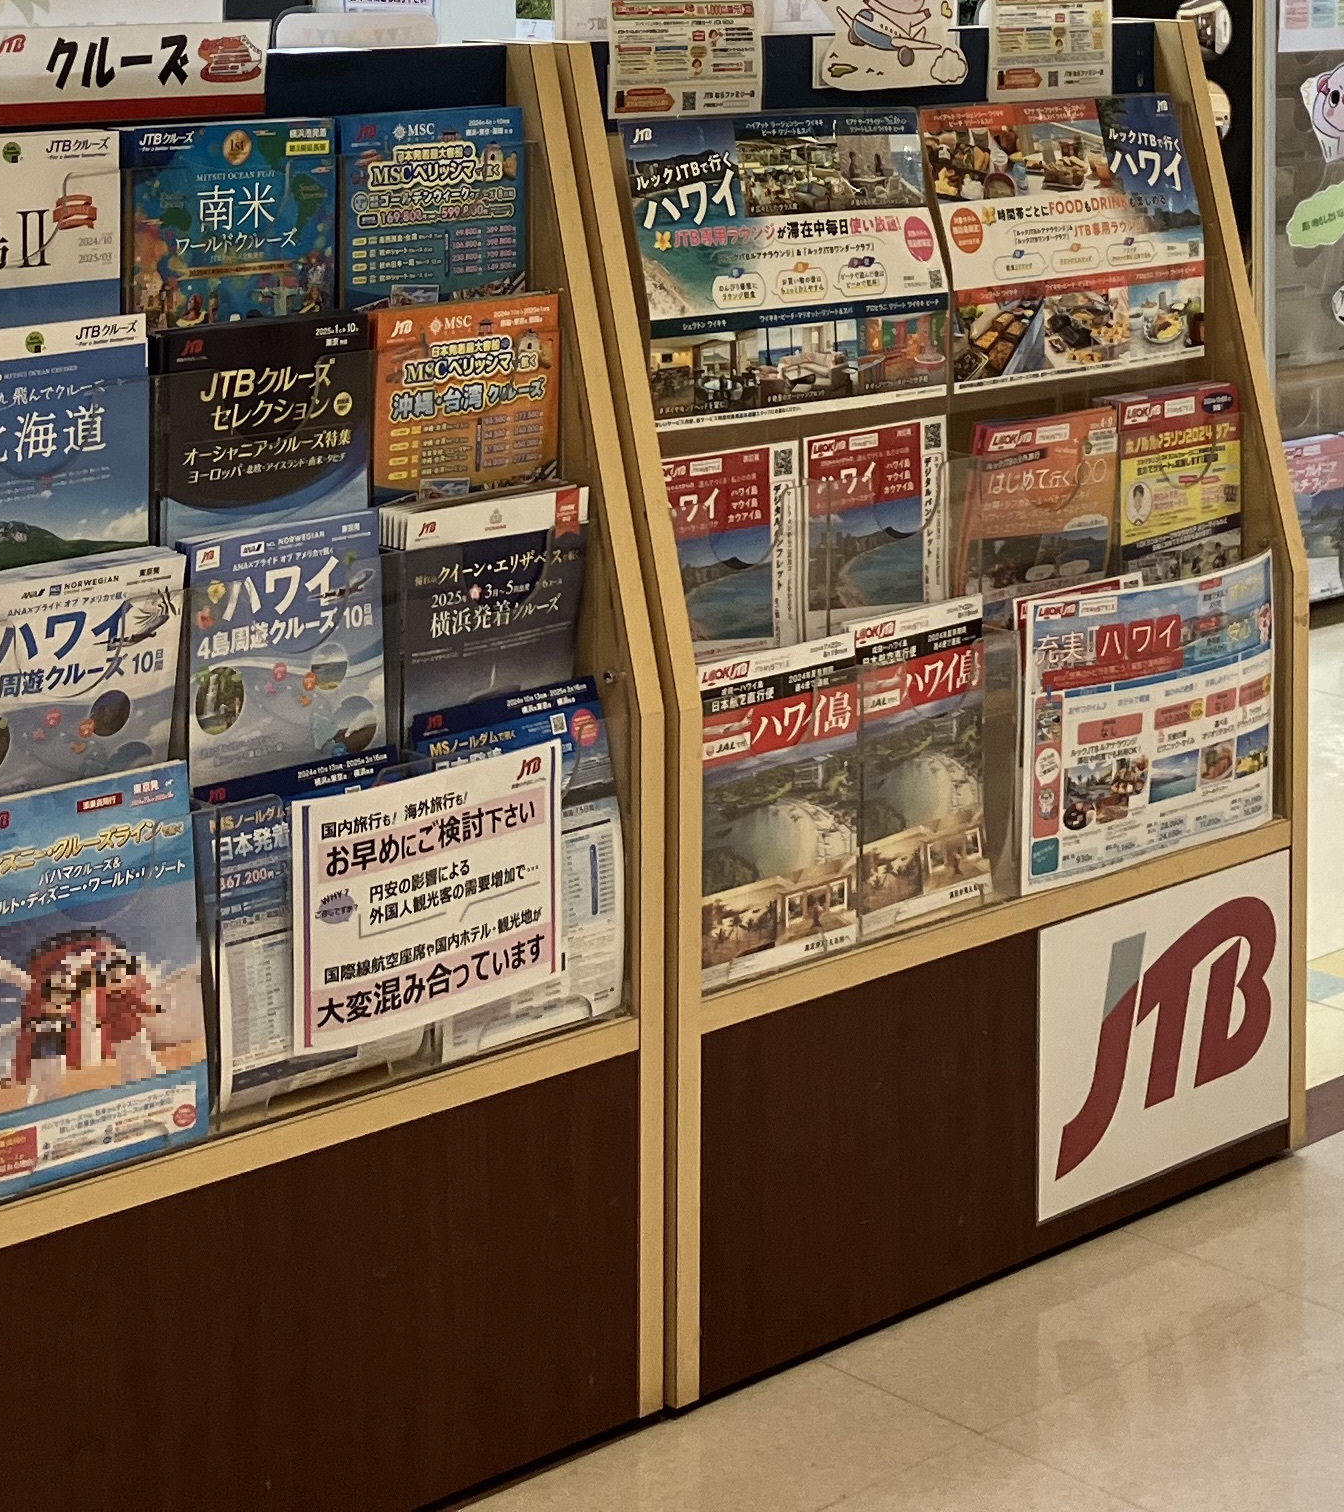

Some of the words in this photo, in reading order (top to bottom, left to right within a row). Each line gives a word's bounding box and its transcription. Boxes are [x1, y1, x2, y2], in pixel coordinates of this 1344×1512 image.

[45, 34, 190, 90] クルーズ
[46, 137, 109, 155] JTBクルーズ
[139, 130, 194, 146] JTBクルーズ
[407, 123, 435, 137] MSC
[632, 127, 652, 143] JTB
[1108, 128, 1181, 152] ルックJTBで行く
[228, 172, 254, 180] OCEAN
[636, 151, 733, 191] ルックJTBで行く
[1110, 150, 1183, 191] ハワイ
[196, 182, 275, 230] 南米
[643, 169, 738, 230] ハワイ
[78, 235, 112, 248] 2024/10
[175, 228, 297, 255] ワールドクルーズ
[75, 320, 137, 340] JTBクルーズ
[391, 319, 413, 338] JTB
[444, 315, 473, 329] MSC
[201, 358, 336, 404] JTBクルーズ
[211, 397, 332, 432] セレクション
[278, 531, 325, 545] NORWEGIAN
[418, 520, 437, 538] JTB
[63, 575, 120, 590] NORWEGIAN
[222, 557, 340, 621] ハワイ
[430, 593, 562, 639] 横浜発着クルーズ
[906, 649, 981, 698] ハワイ島
[751, 691, 850, 745] ハワイ島
[715, 741, 737, 752] JAL
[516, 756, 542, 781] JTB
[320, 808, 397, 839] 国内旅行も!
[404, 792, 468, 821] 海外旅行も!
[325, 800, 536, 876] お早めにご検討下さい
[39, 857, 121, 886] バハマクルーズ&
[369, 859, 470, 903] 円安の影響による
[324, 906, 542, 983] 国際線航空座席や国内ホテル・観光地が
[317, 935, 545, 1027] 大変混み合っています
[1055, 896, 1277, 1182] JTB
